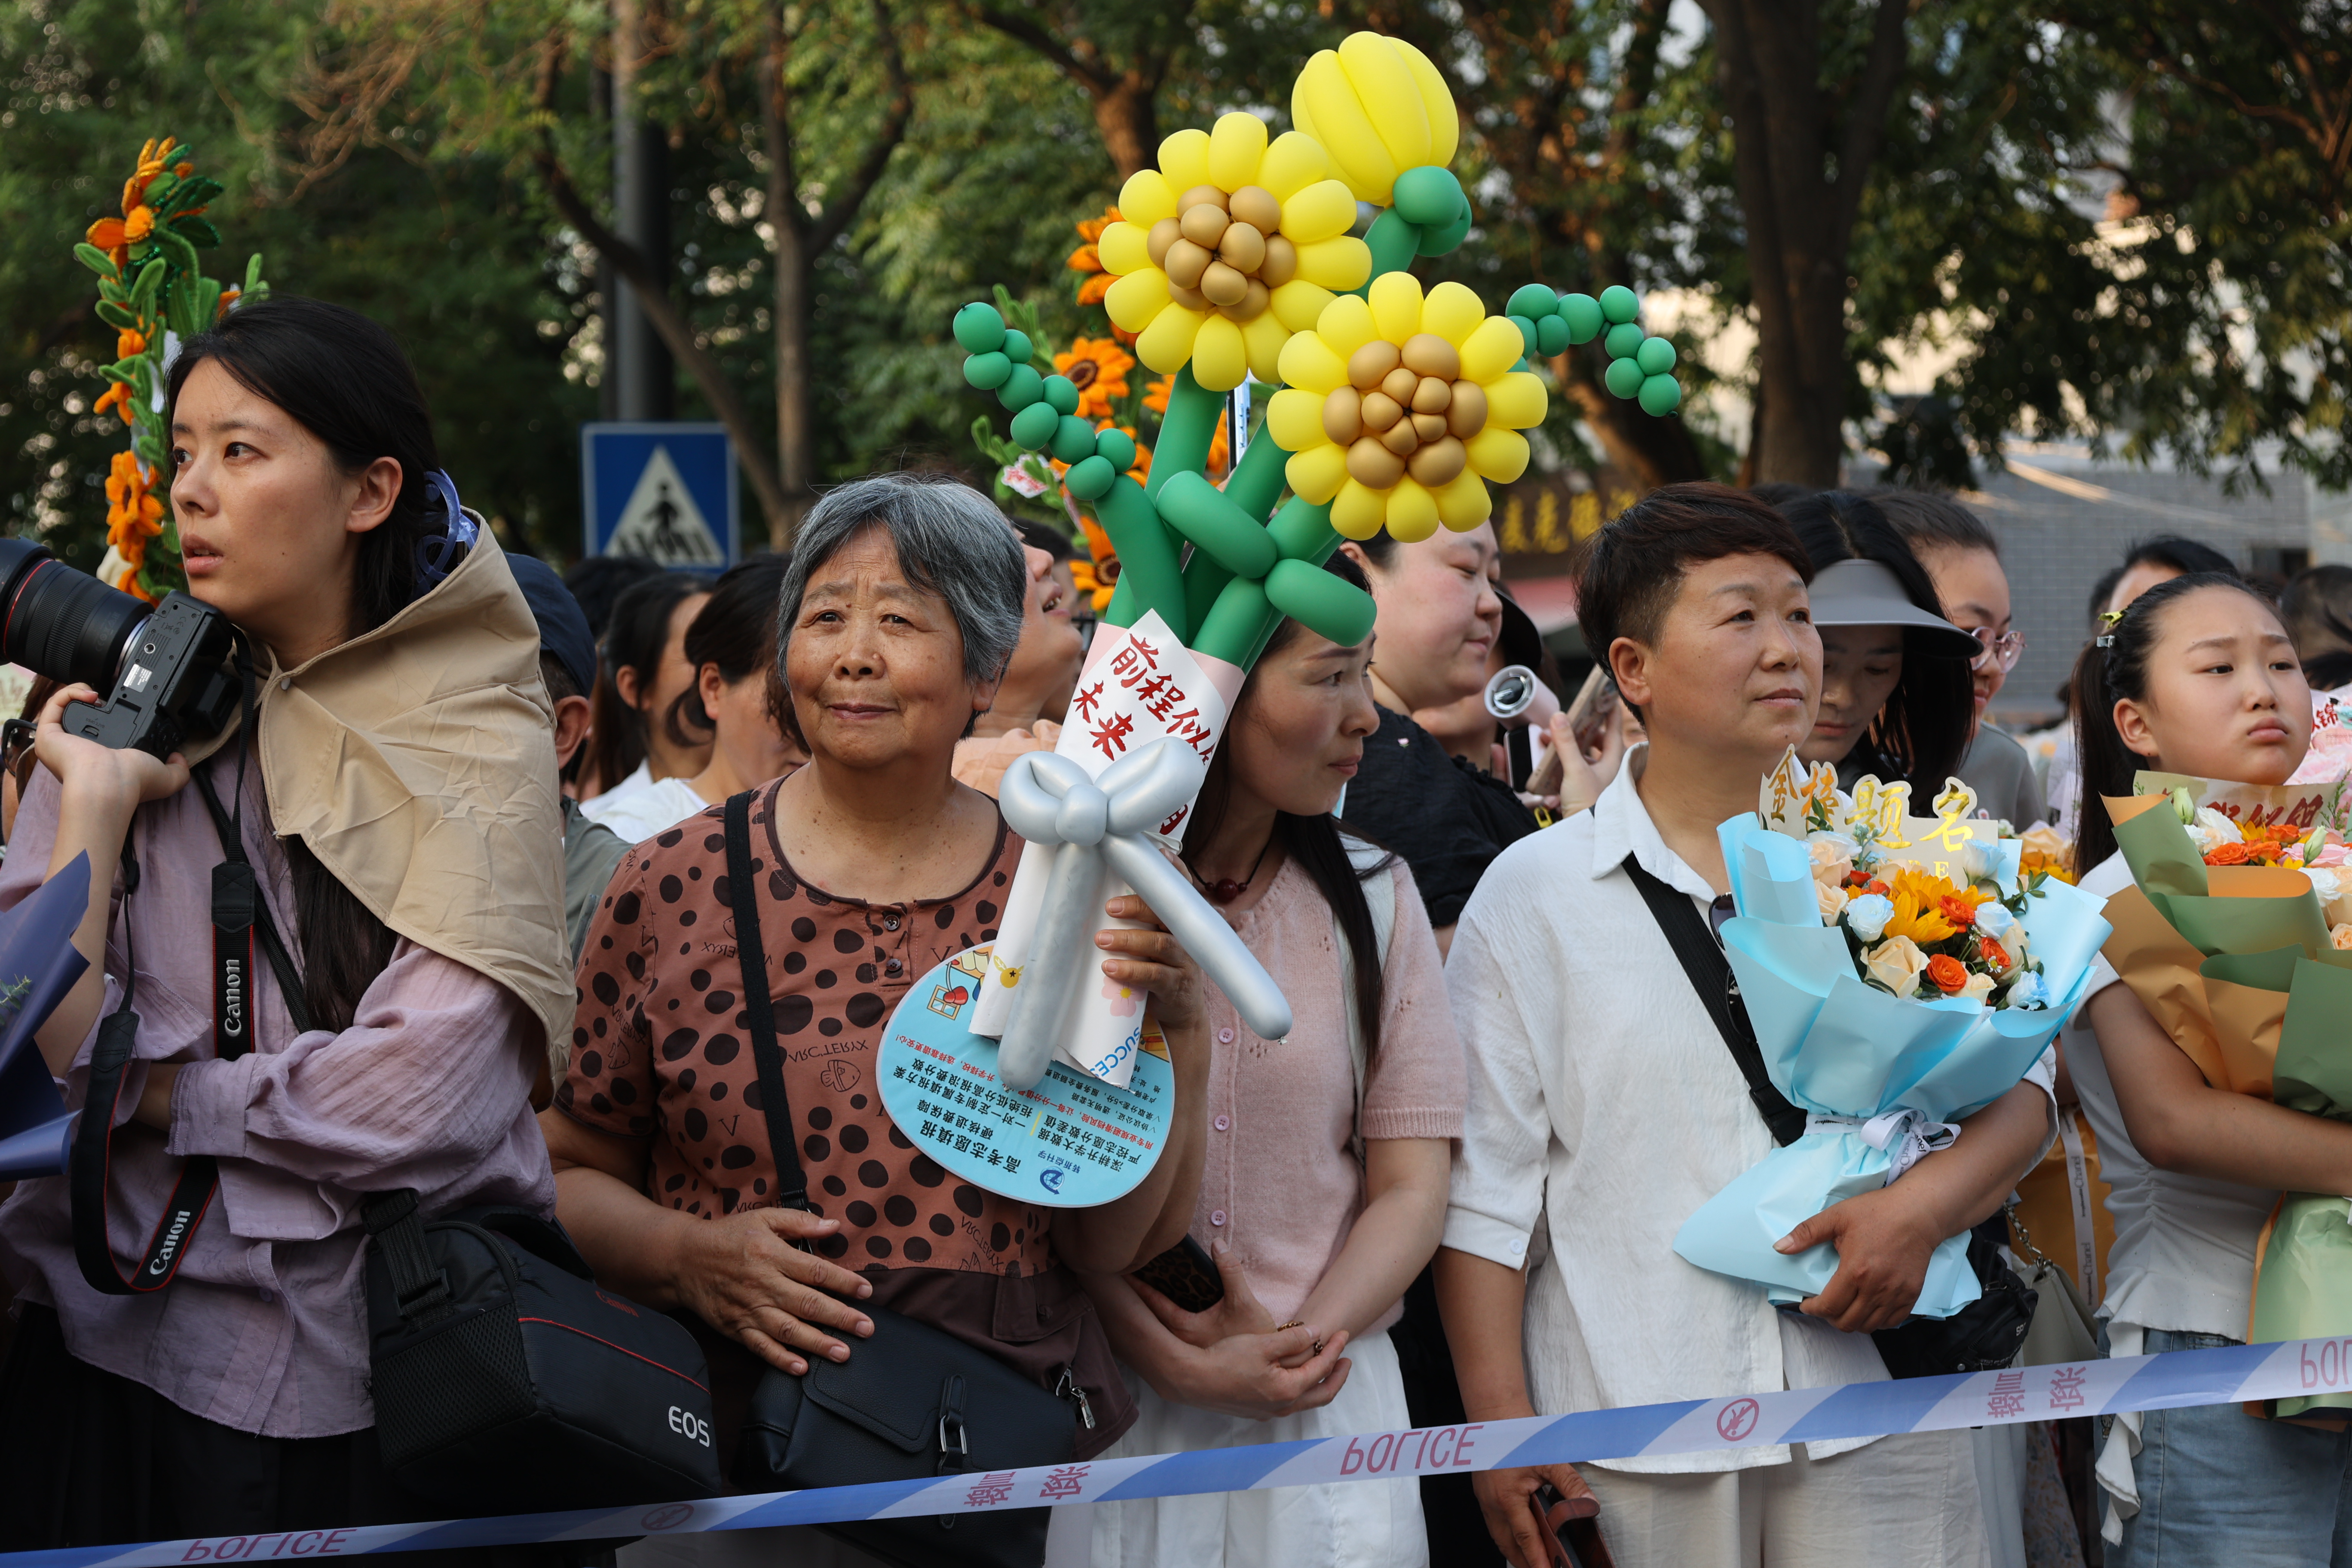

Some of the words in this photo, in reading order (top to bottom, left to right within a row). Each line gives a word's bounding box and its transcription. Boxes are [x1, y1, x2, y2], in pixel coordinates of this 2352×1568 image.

[1768, 744, 1974, 853] 金榜题名
[224, 959, 240, 1037] Canon
[892, 1065, 1026, 1128] 一对一定制专属填报方案
[910, 1057, 1034, 1119] 拒绝低分高报浪费分数
[916, 1098, 995, 1140] 硬核退费保障
[1043, 1114, 1142, 1165] 严控志愿分数差值
[919, 1119, 1022, 1175] 高考志愿填报
[1037, 1127, 1124, 1173] 深耕升学大数据
[1037, 1149, 1081, 1174] 转折点升学
[2071, 1155, 2084, 1188] Chanel
[149, 1209, 191, 1276] Canon
[2081, 1242, 2093, 1276] Chanel
[595, 1289, 639, 1318] Canon
[668, 1405, 710, 1448] EOS
